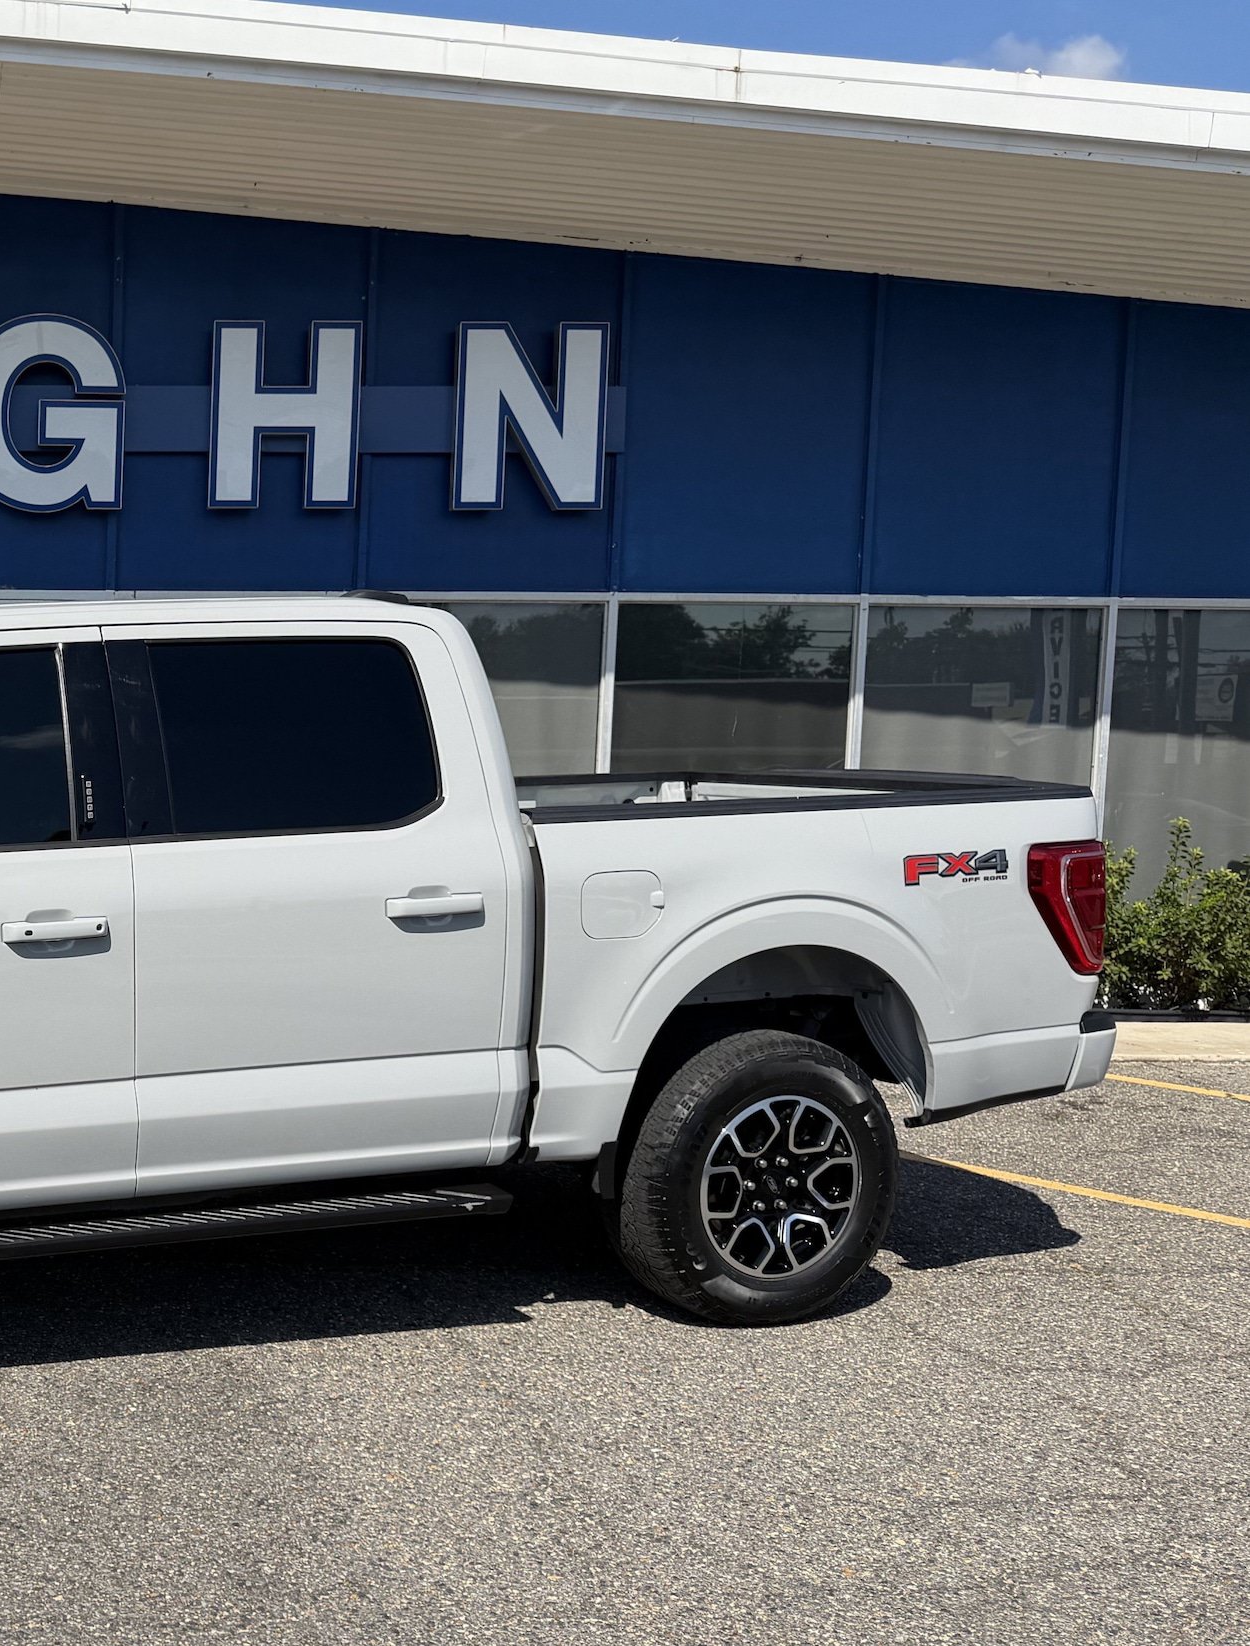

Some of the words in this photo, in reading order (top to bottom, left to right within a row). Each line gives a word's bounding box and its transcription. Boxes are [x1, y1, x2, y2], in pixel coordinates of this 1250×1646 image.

[903, 848, 1009, 887] FX4
[961, 876, 981, 884] OFF
[983, 874, 1008, 882] ROAD
